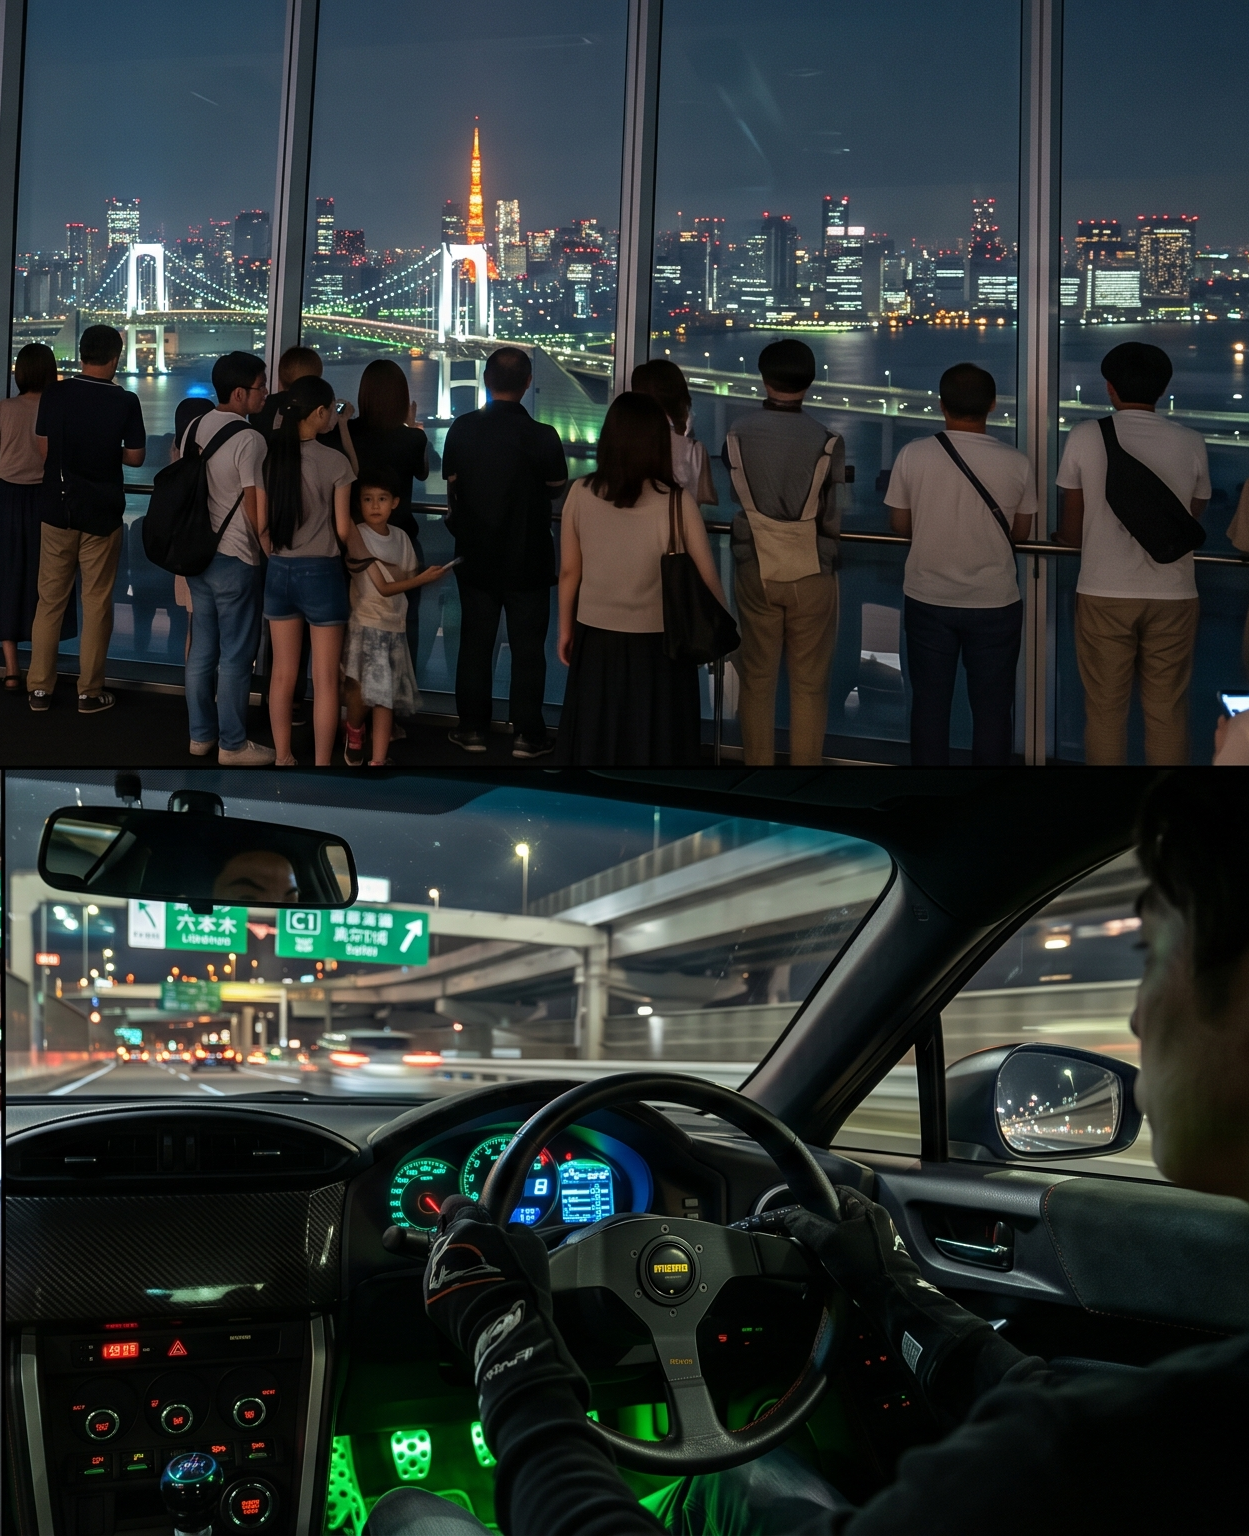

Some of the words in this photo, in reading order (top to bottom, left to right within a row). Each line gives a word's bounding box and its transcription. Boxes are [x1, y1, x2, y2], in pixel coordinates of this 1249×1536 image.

[176, 914, 237, 935] 六本木
[291, 913, 315, 930] C1
